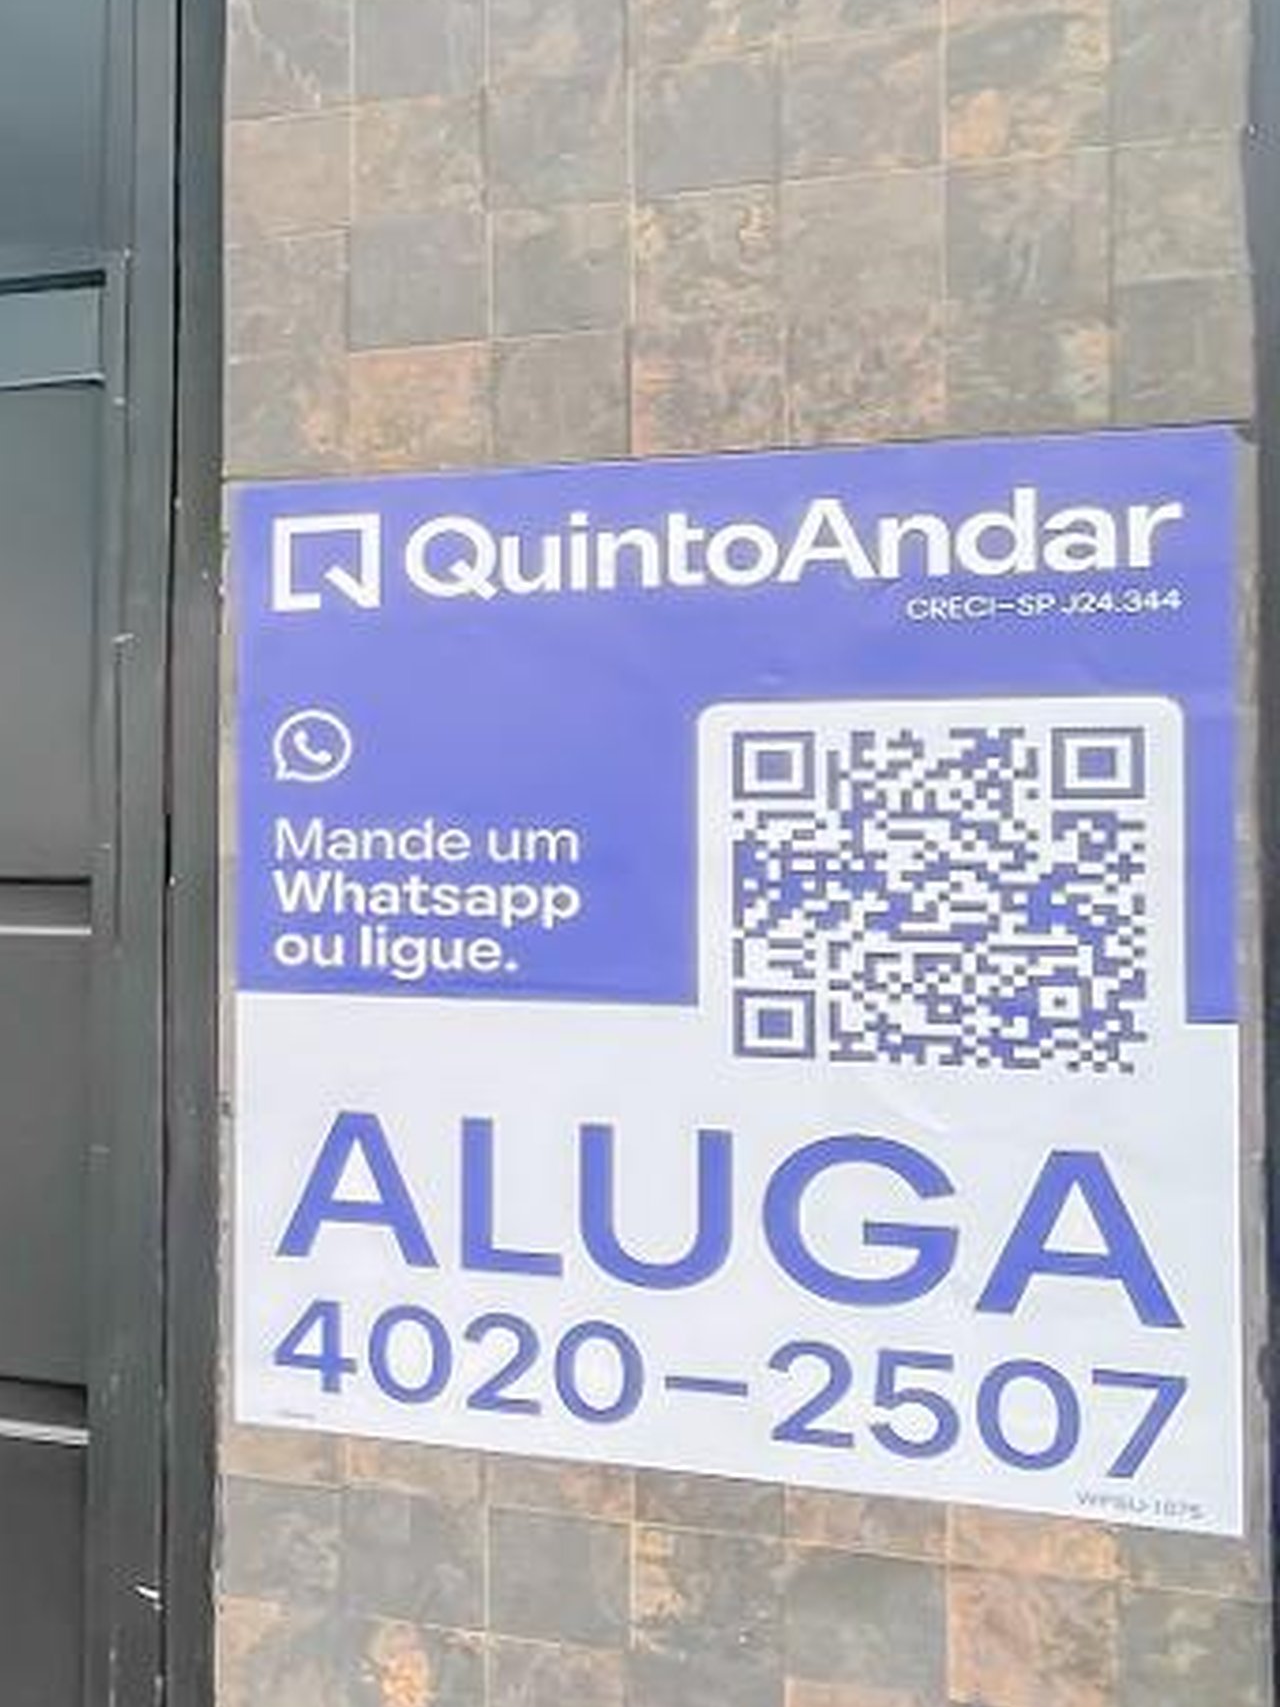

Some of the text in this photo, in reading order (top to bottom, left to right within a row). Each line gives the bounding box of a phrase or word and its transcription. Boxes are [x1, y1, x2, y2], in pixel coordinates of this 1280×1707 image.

[403, 487, 1186, 598] QuintoAndar
[273, 816, 581, 862] Mande um
[272, 869, 582, 930] Whatsapp
[274, 924, 519, 981] ou ligue.
[275, 1110, 1187, 1329] ALUGA
[272, 1298, 1191, 1480] 4020-2507
